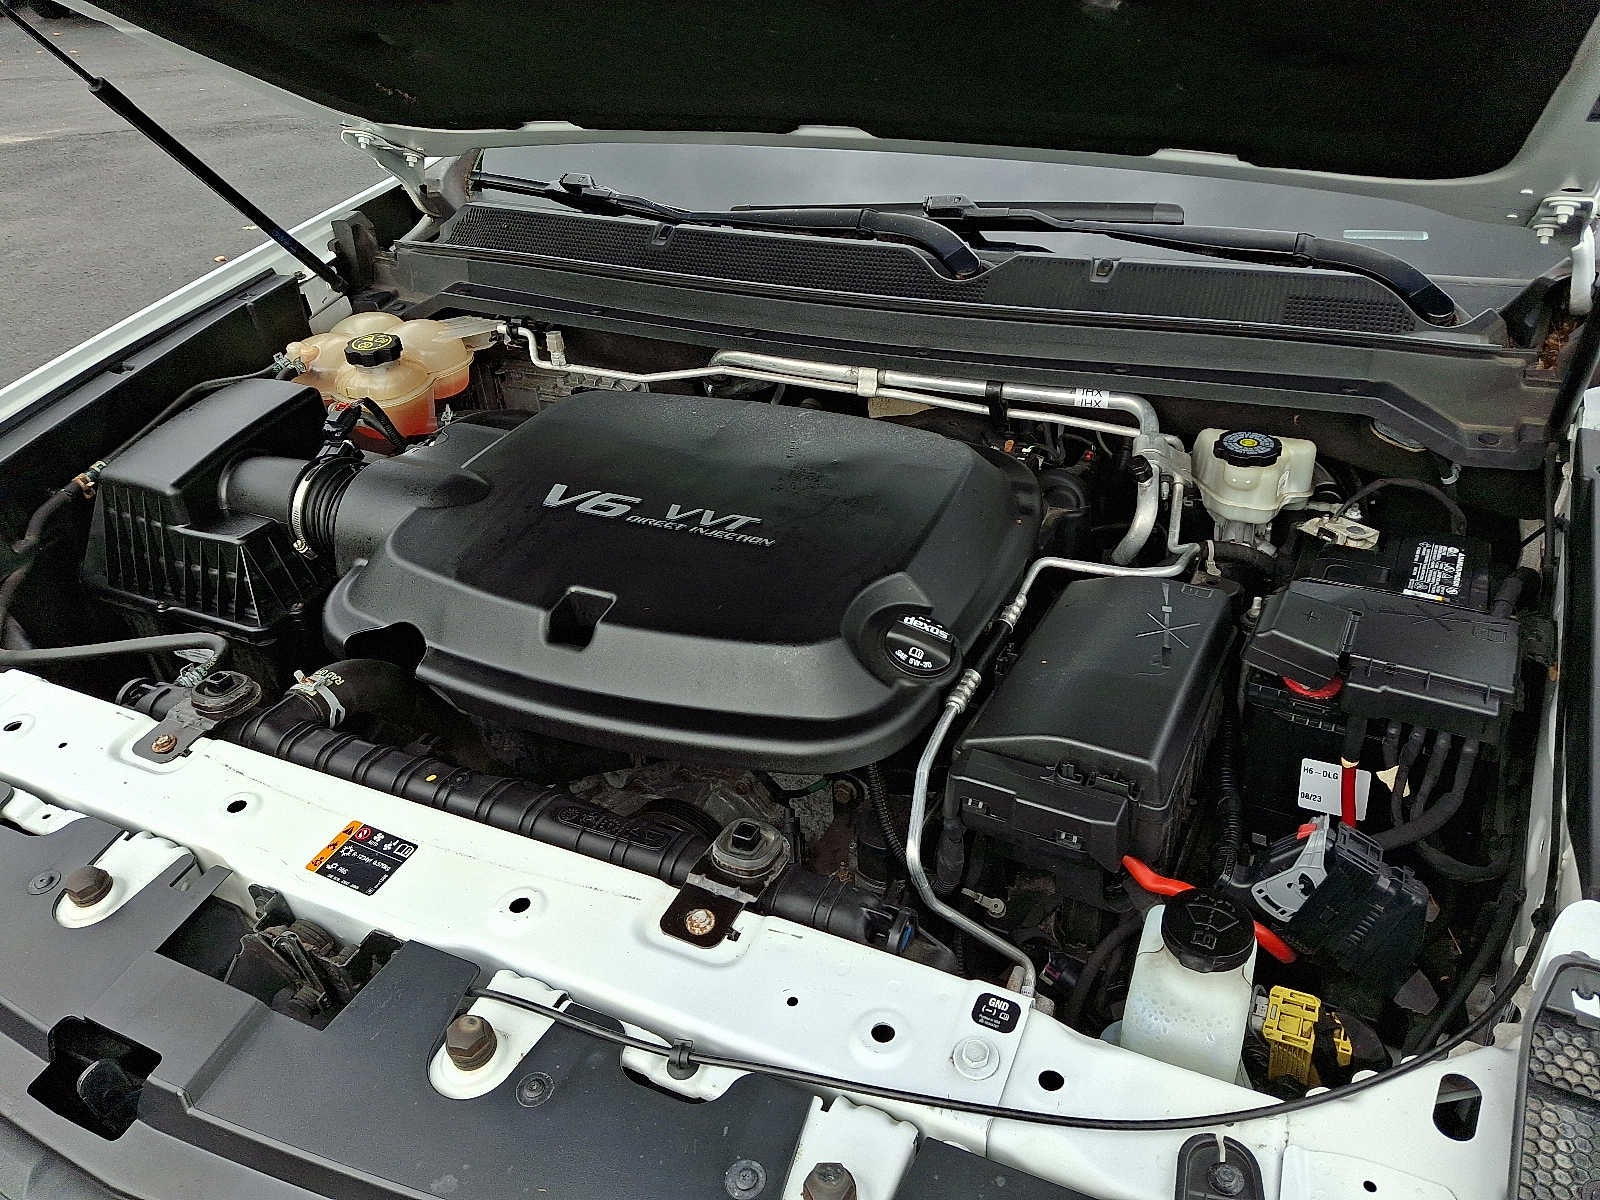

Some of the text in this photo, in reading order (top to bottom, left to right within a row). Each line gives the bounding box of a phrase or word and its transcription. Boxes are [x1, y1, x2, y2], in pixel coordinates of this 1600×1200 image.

[542, 483, 643, 517] V6
[665, 503, 763, 531] VVT
[625, 515, 776, 547] DIRECT INJECTION
[903, 616, 950, 640] dexos
[1300, 791, 1322, 803] 08/23
[988, 997, 1010, 1011] GND
